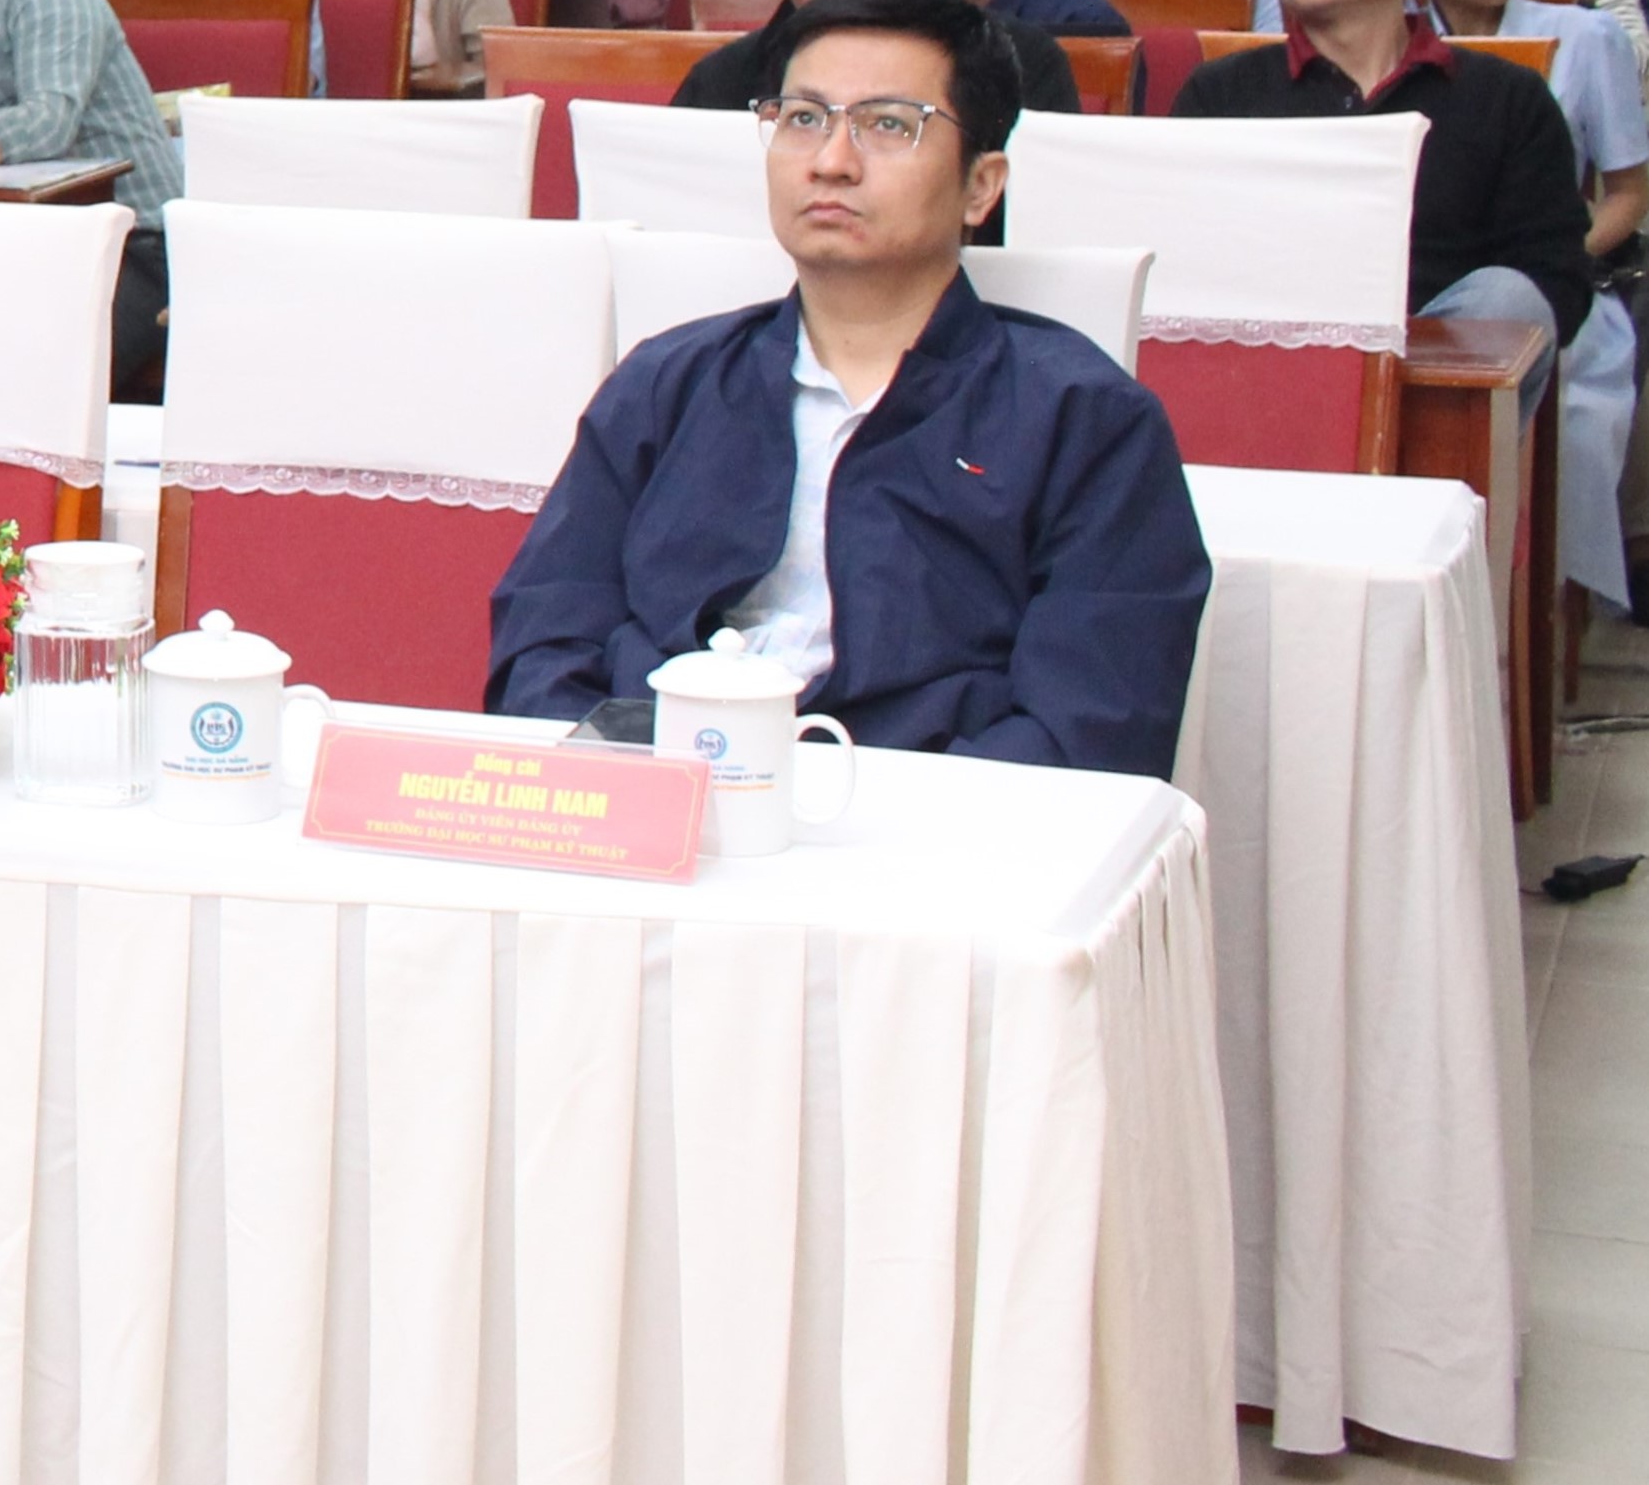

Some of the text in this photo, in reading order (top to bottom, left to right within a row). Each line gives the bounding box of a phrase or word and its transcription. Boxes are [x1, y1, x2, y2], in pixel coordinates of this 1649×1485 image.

[474, 751, 541, 777] Đồng chí
[398, 770, 608, 819] NGUYỄN LINH NAM
